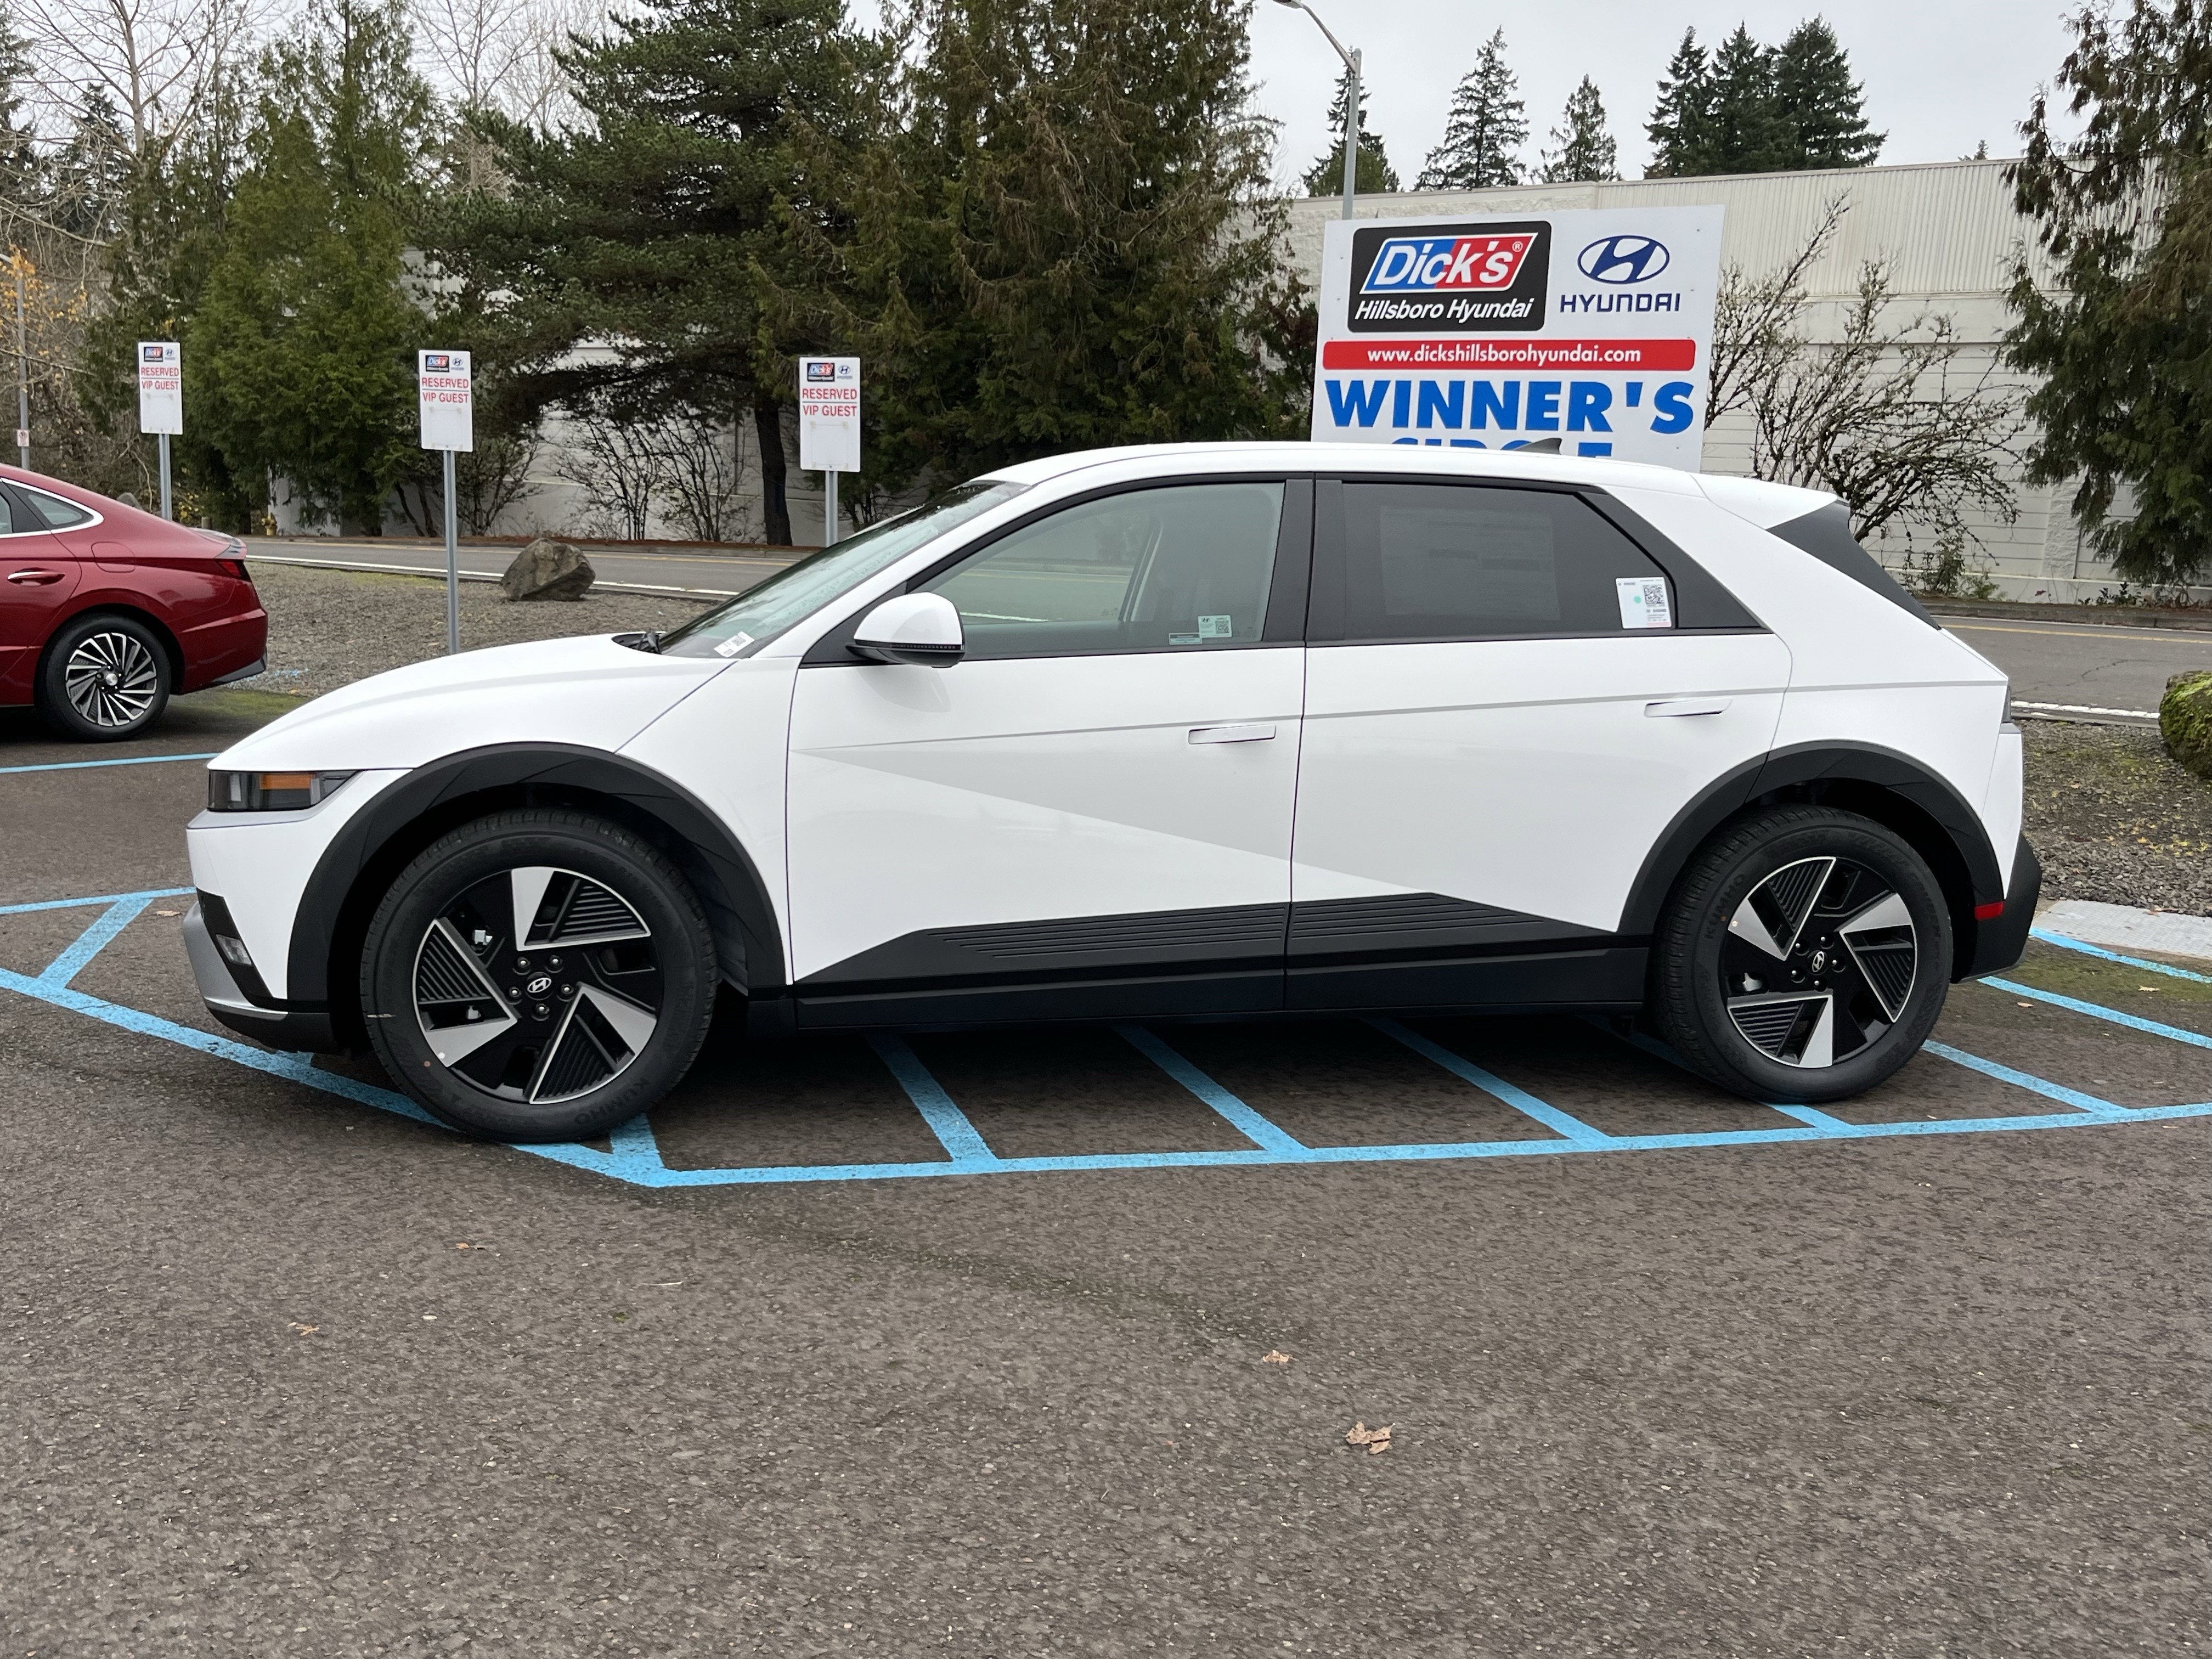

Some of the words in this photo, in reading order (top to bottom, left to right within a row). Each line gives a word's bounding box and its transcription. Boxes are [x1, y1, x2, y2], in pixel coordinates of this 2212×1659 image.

[1373, 240, 1514, 285] Dick's
[1355, 300, 1444, 320] Hillsboro
[1446, 298, 1534, 324] Hyundai
[1560, 293, 1680, 313] HYUNDAI
[1367, 343, 1641, 367] www.dickshillsborohyundai.com
[140, 366, 179, 376] RESERVED
[142, 380, 153, 390] VIP
[155, 381, 179, 390] GUEST
[421, 377, 469, 388] RESERVED
[422, 392, 436, 402] VIP
[439, 392, 469, 403] GUEST
[802, 388, 857, 400] RESERVED
[803, 405, 819, 416] VIP
[822, 405, 857, 417] GUEST
[1324, 380, 1694, 434] WINNER'S
[1704, 874, 1745, 939] KUMHO
[574, 1076, 650, 1125] KUMHO
